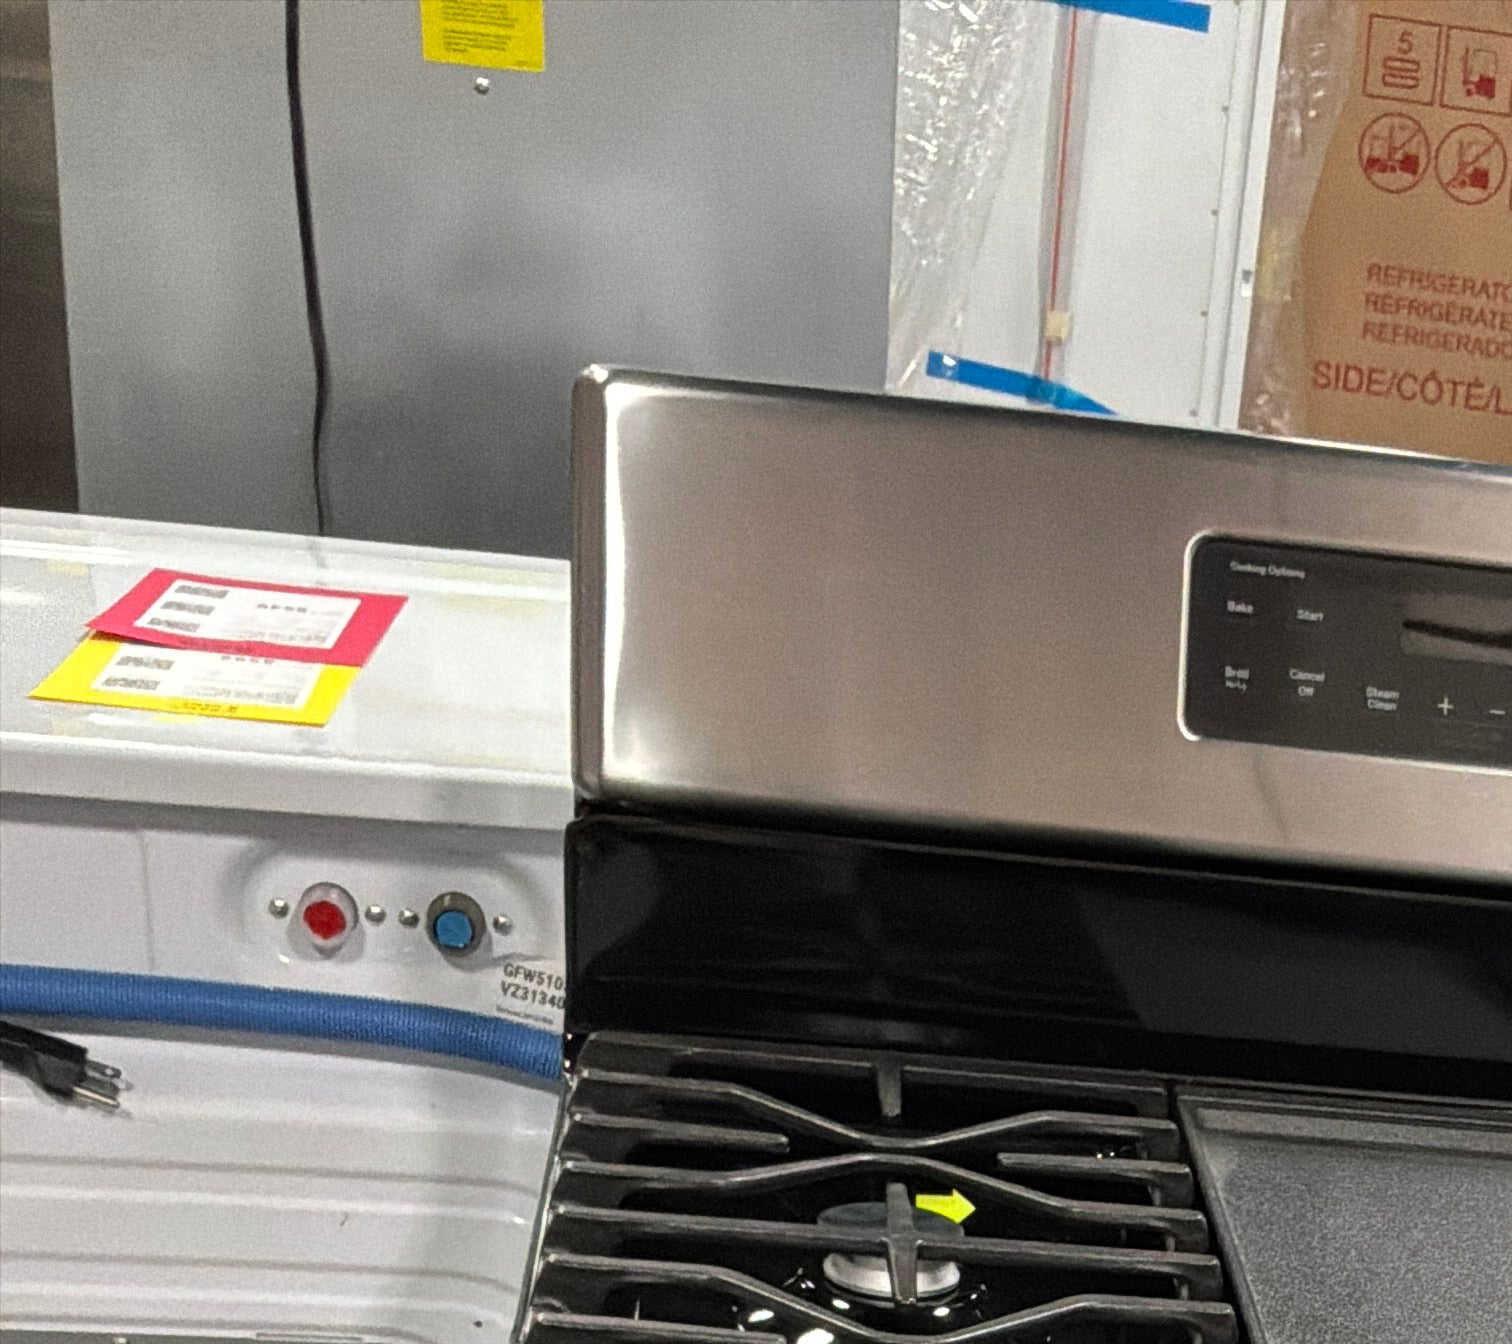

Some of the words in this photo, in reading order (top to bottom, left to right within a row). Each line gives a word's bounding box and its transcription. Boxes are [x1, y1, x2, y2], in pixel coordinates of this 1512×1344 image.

[1227, 600, 1254, 614] Bake
[1297, 609, 1324, 621] Start
[1289, 668, 1325, 682] Cancel
[1366, 686, 1400, 699] Steam
[1367, 699, 1397, 711] Clean
[503, 962, 564, 992] GFW510
